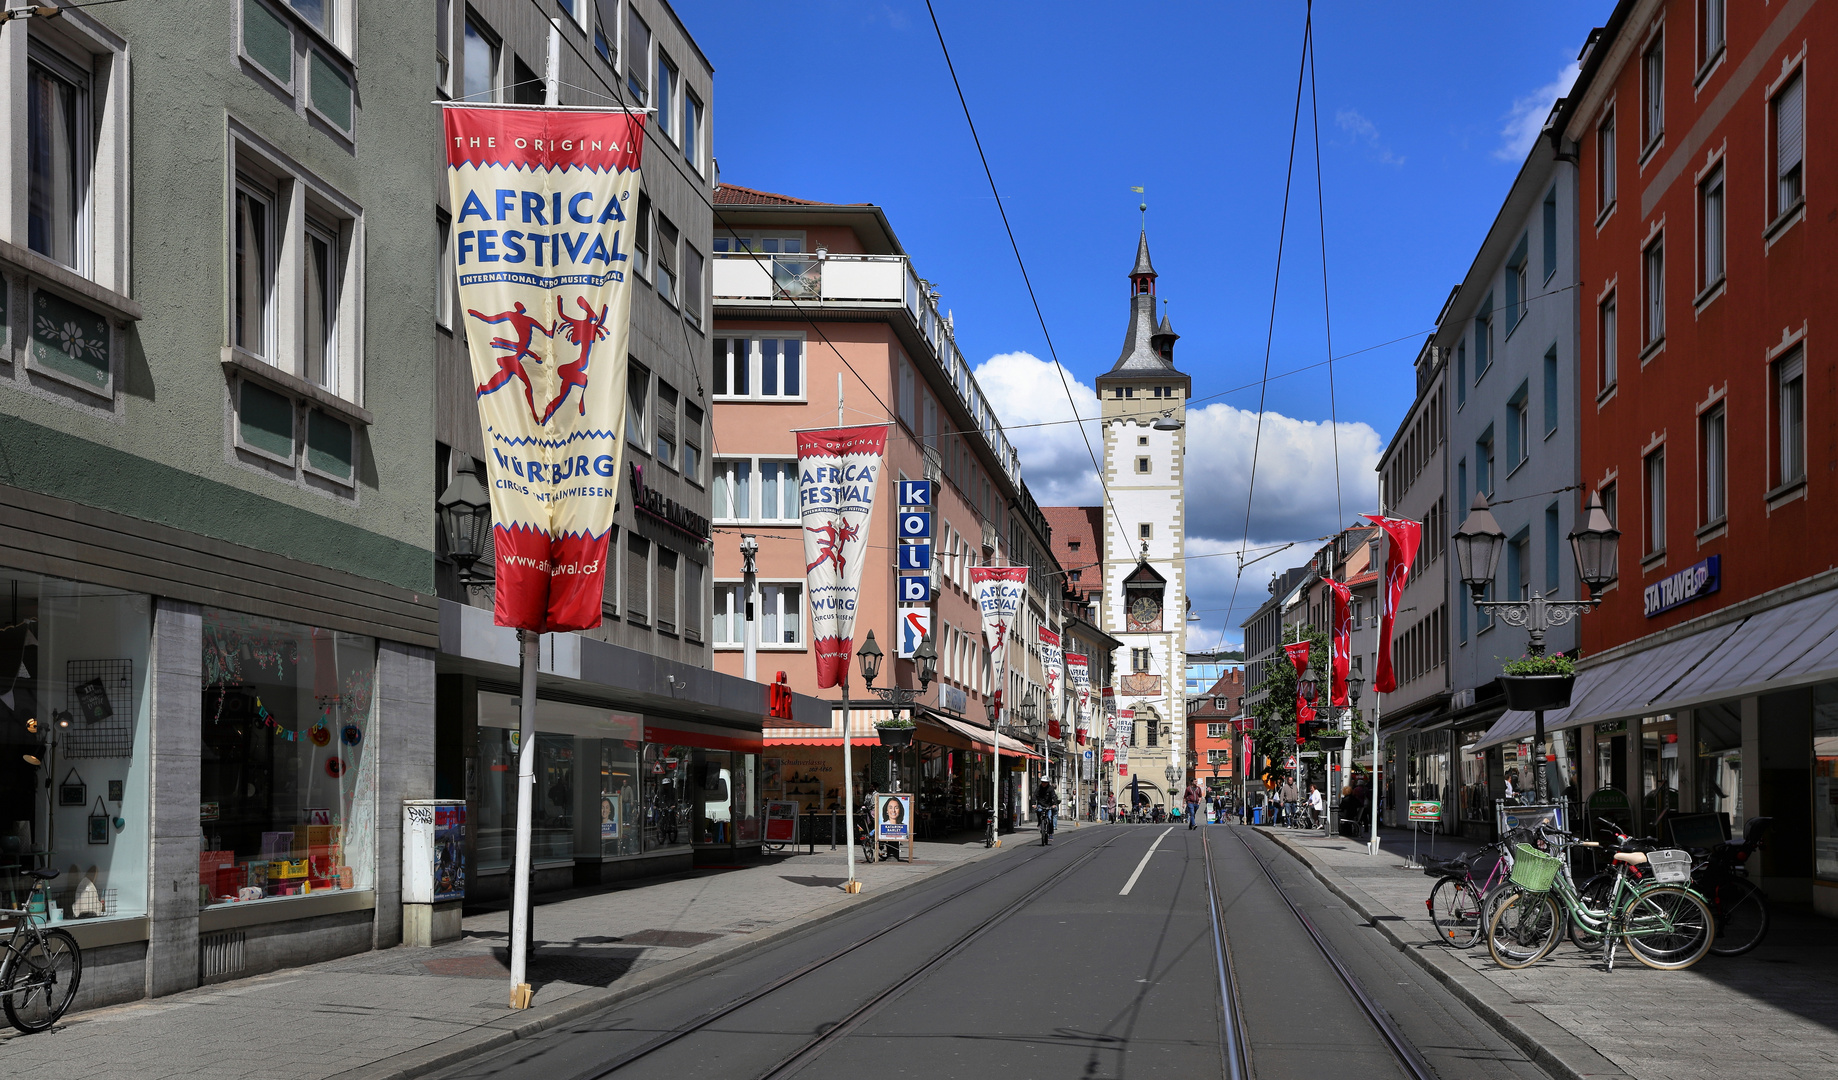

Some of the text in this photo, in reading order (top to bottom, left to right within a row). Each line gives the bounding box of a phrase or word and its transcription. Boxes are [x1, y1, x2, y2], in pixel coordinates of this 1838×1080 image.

[454, 137, 633, 154] THE ORIGINAL
[458, 229, 628, 267] FESTIVAL
[463, 273, 536, 285] INTERNATIONAL
[539, 279, 558, 288] AFRO
[561, 275, 588, 284] MUSIC
[826, 439, 880, 449] ORIGINAL
[1644, 583, 1660, 615] STA
[1661, 567, 1696, 607] TRAVEL
